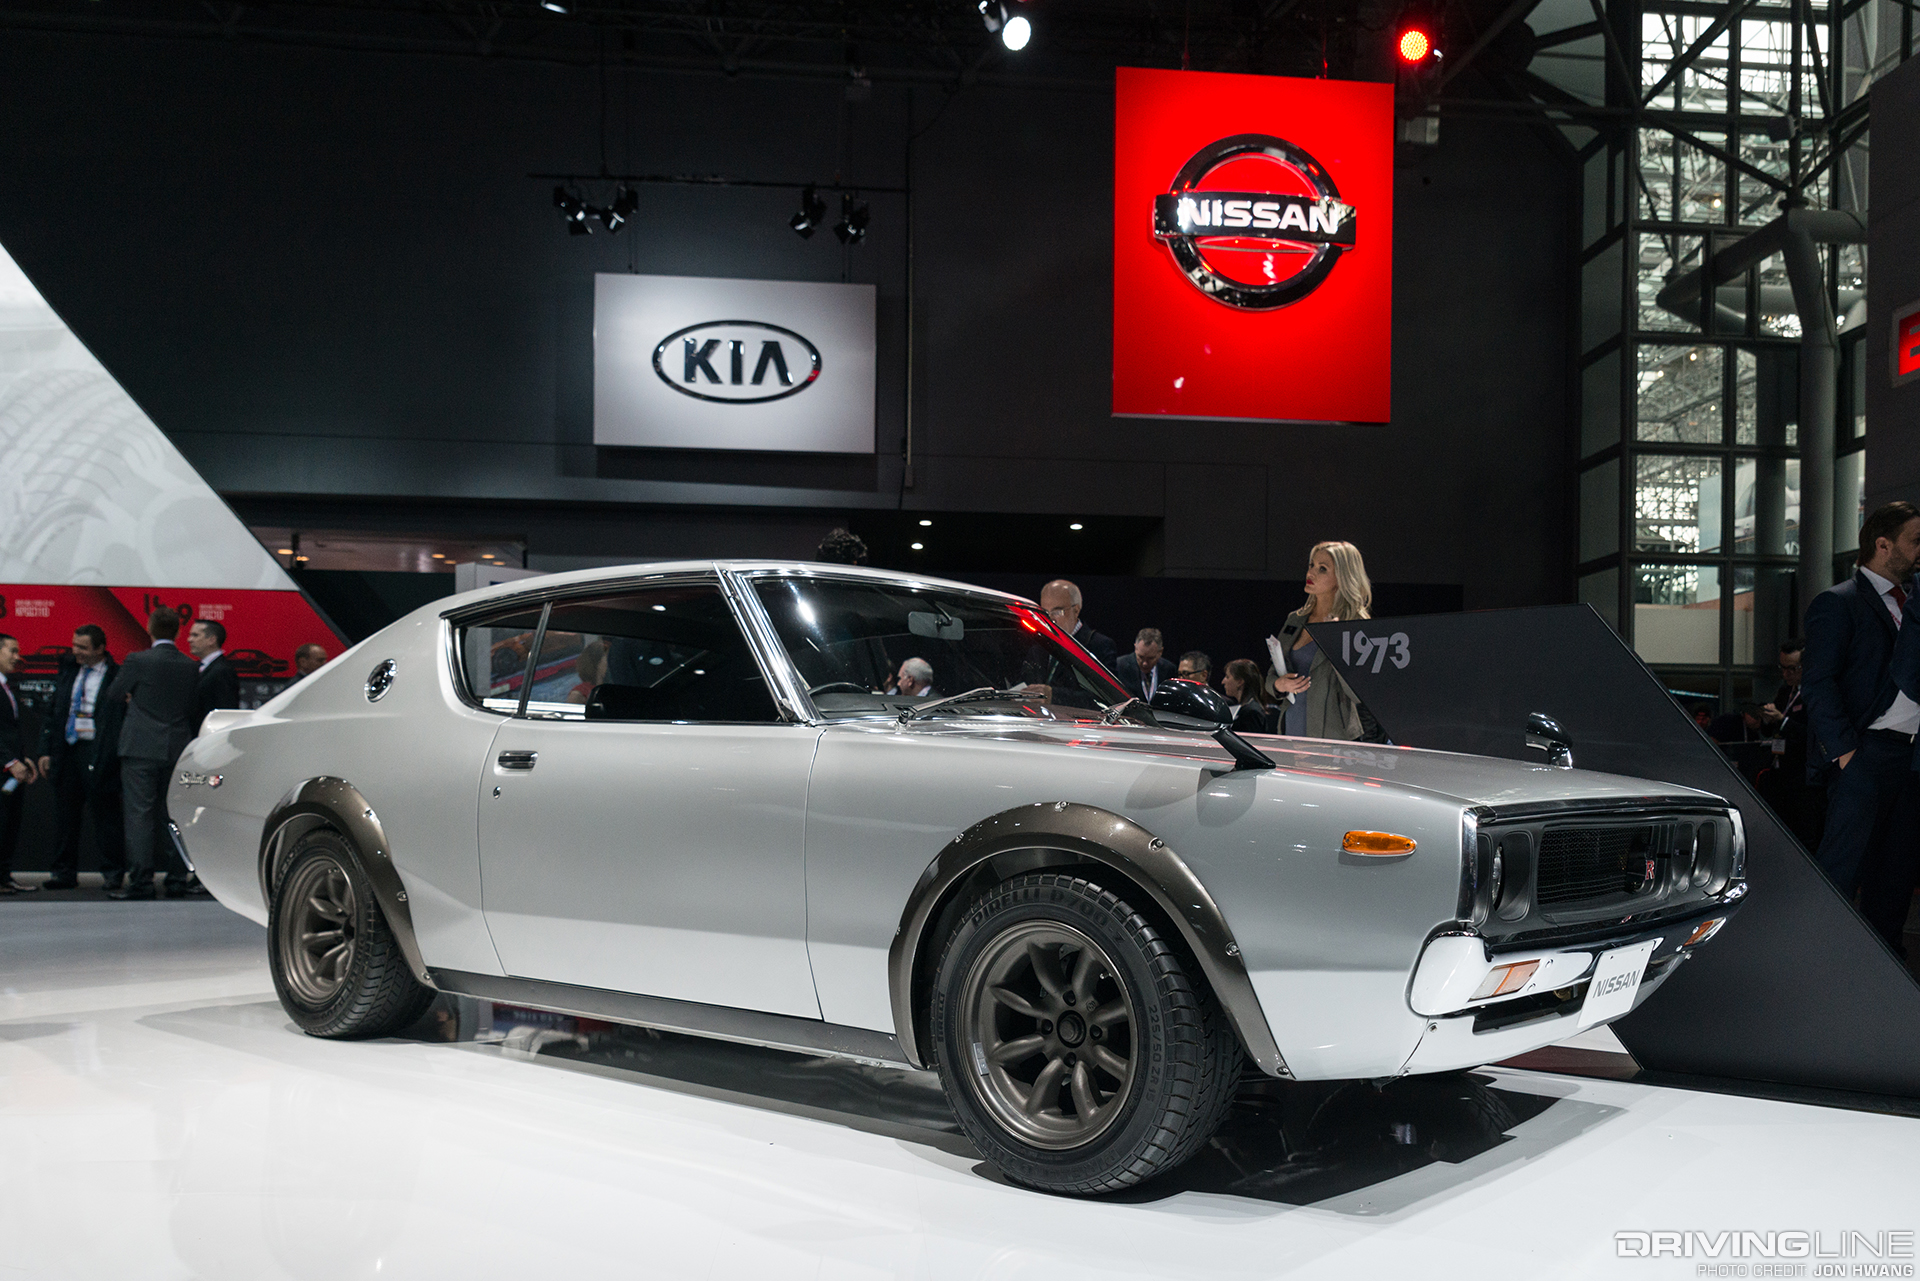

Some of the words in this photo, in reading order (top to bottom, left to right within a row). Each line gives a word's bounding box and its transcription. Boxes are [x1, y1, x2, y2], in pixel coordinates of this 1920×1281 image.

[1177, 198, 1339, 235] NISSAN
[683, 338, 794, 387] KIA
[1342, 630, 1411, 674] 1973
[1592, 969, 1641, 999] NISSAN
